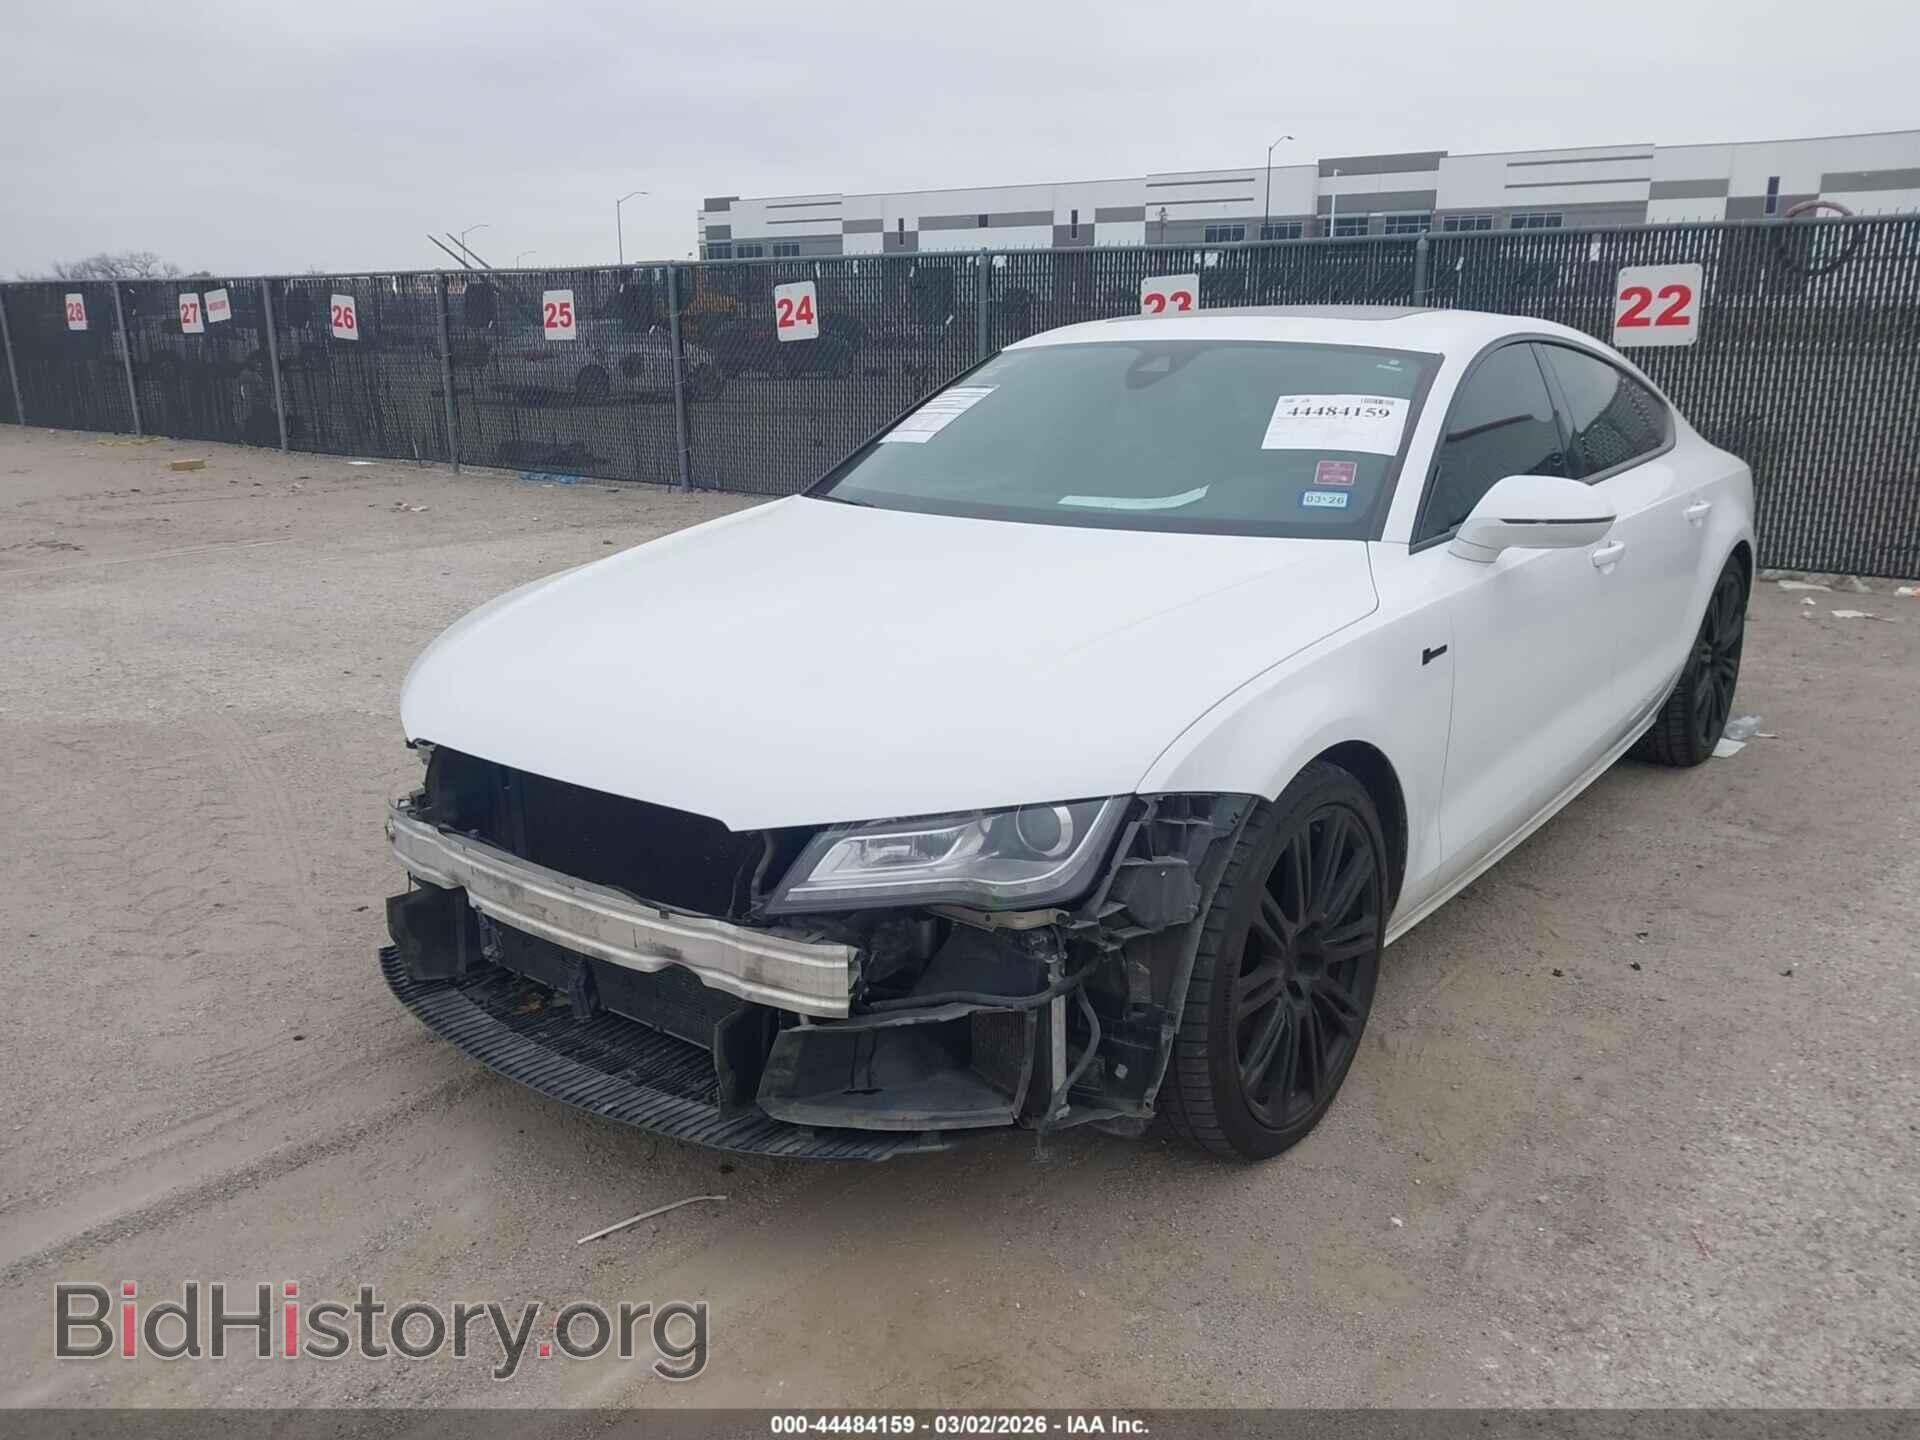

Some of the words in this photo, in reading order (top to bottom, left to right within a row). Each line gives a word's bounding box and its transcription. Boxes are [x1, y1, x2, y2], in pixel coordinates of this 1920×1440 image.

[67, 302, 84, 322] 28
[181, 303, 198, 324] 27
[332, 305, 355, 330] 26
[544, 302, 574, 329] 25
[777, 295, 815, 328] 24
[1616, 284, 1693, 328] 22
[1286, 406, 1391, 418] 44484159
